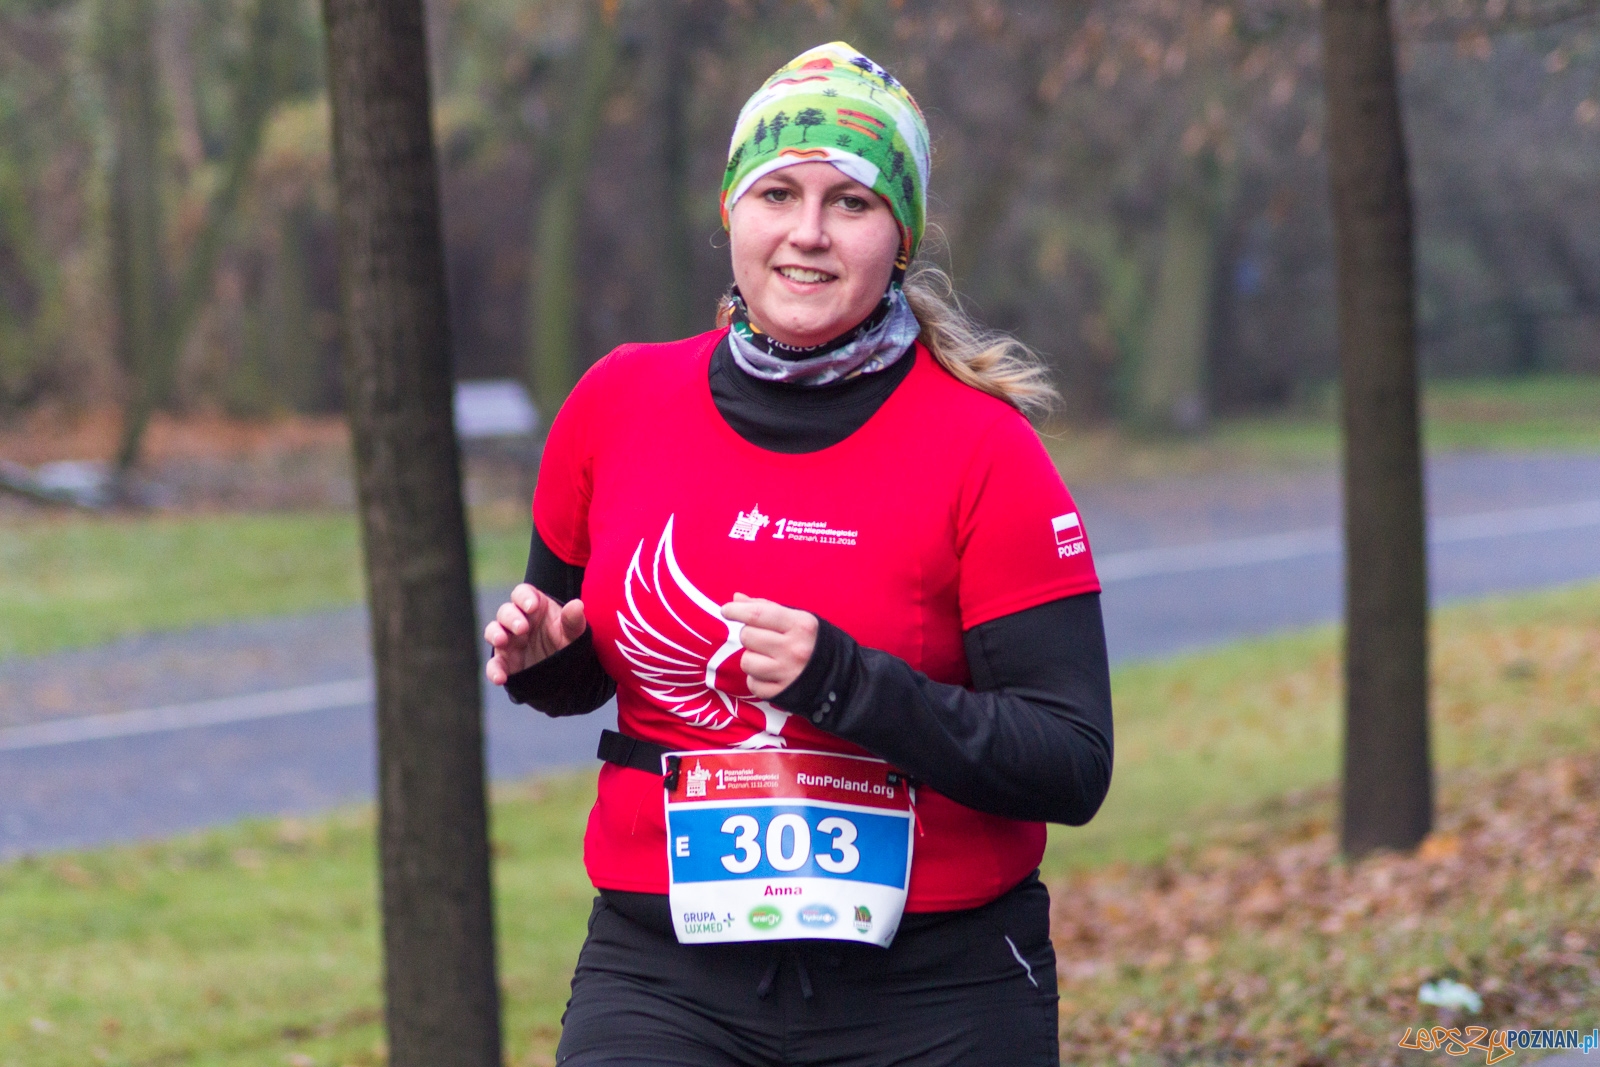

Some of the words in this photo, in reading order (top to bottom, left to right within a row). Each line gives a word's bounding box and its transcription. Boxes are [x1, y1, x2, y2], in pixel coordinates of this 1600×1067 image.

[772, 518, 787, 539] 1
[785, 526, 803, 534] Bieg
[1057, 541, 1086, 559] POLSKA
[714, 768, 727, 790] 1
[796, 772, 895, 799] RunPoland.org
[676, 836, 690, 857] E
[720, 813, 861, 874] 303
[764, 885, 802, 896] Anna
[683, 912, 716, 923] GRUPA
[685, 923, 723, 934] LUXMED
